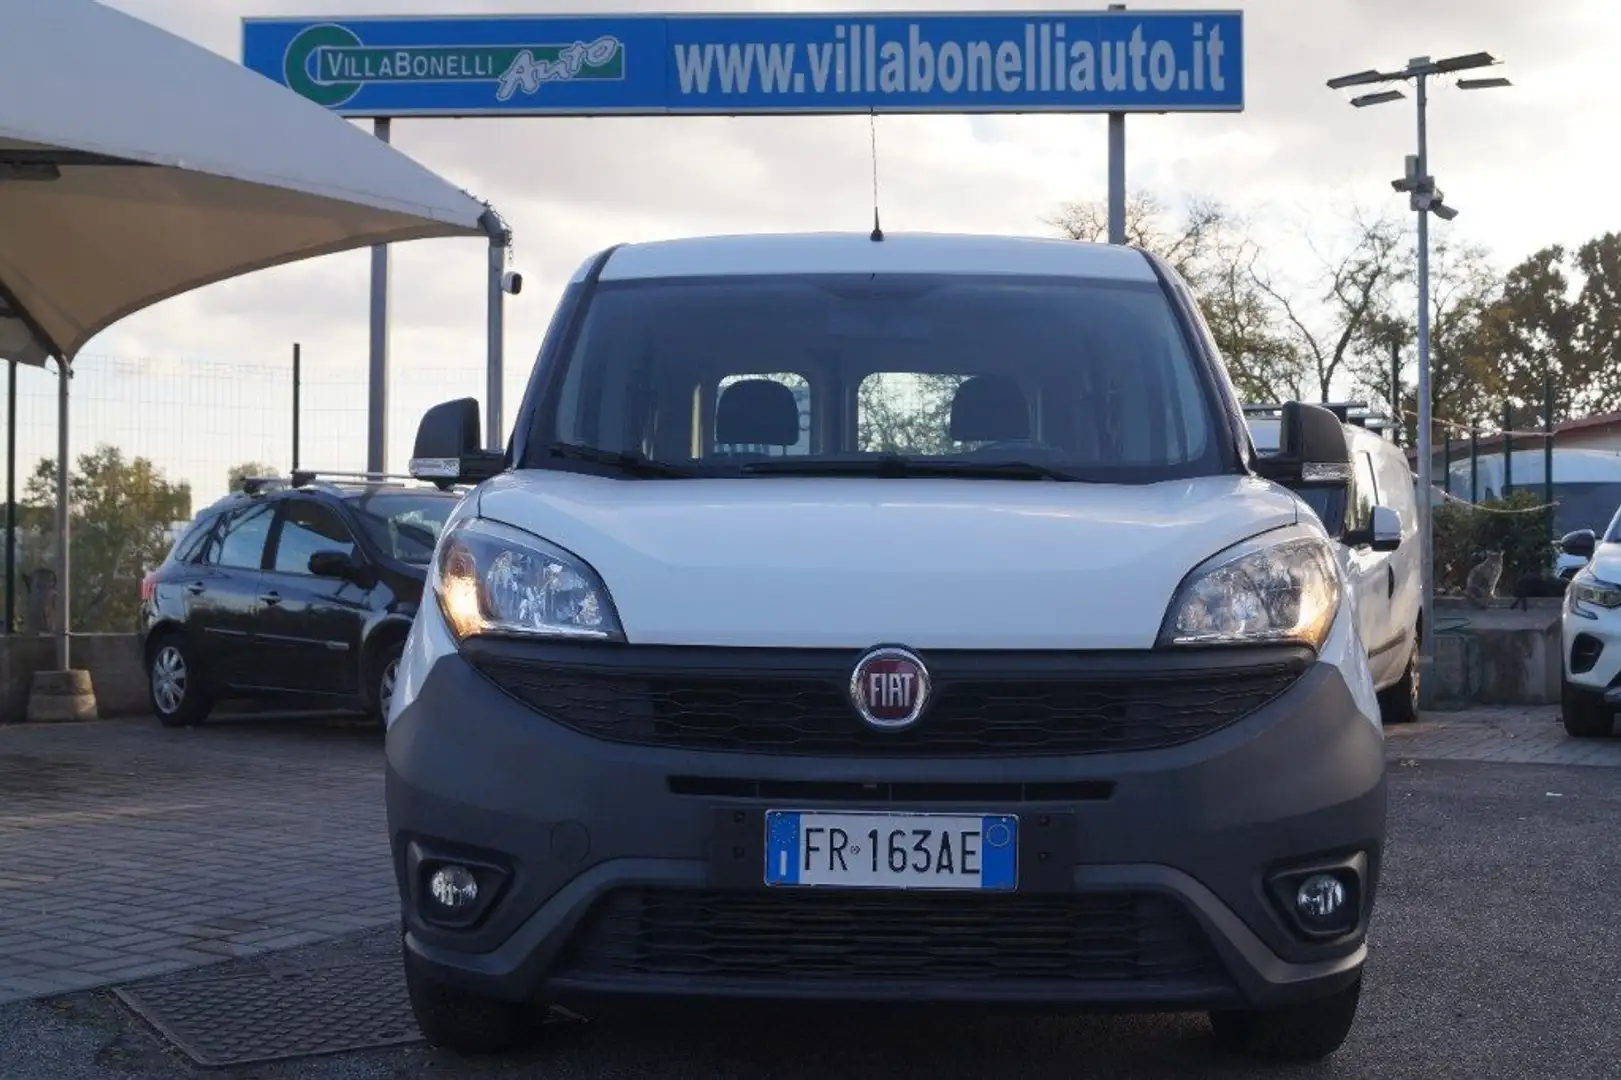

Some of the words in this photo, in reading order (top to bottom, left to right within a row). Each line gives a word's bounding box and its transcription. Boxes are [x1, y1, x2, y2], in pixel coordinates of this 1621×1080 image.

[497, 36, 619, 101] Auto
[674, 22, 1225, 94] www.villabonelliauto.it
[870, 673, 914, 706] FIAT
[804, 828, 848, 871] FR
[868, 829, 980, 874] 163AE
